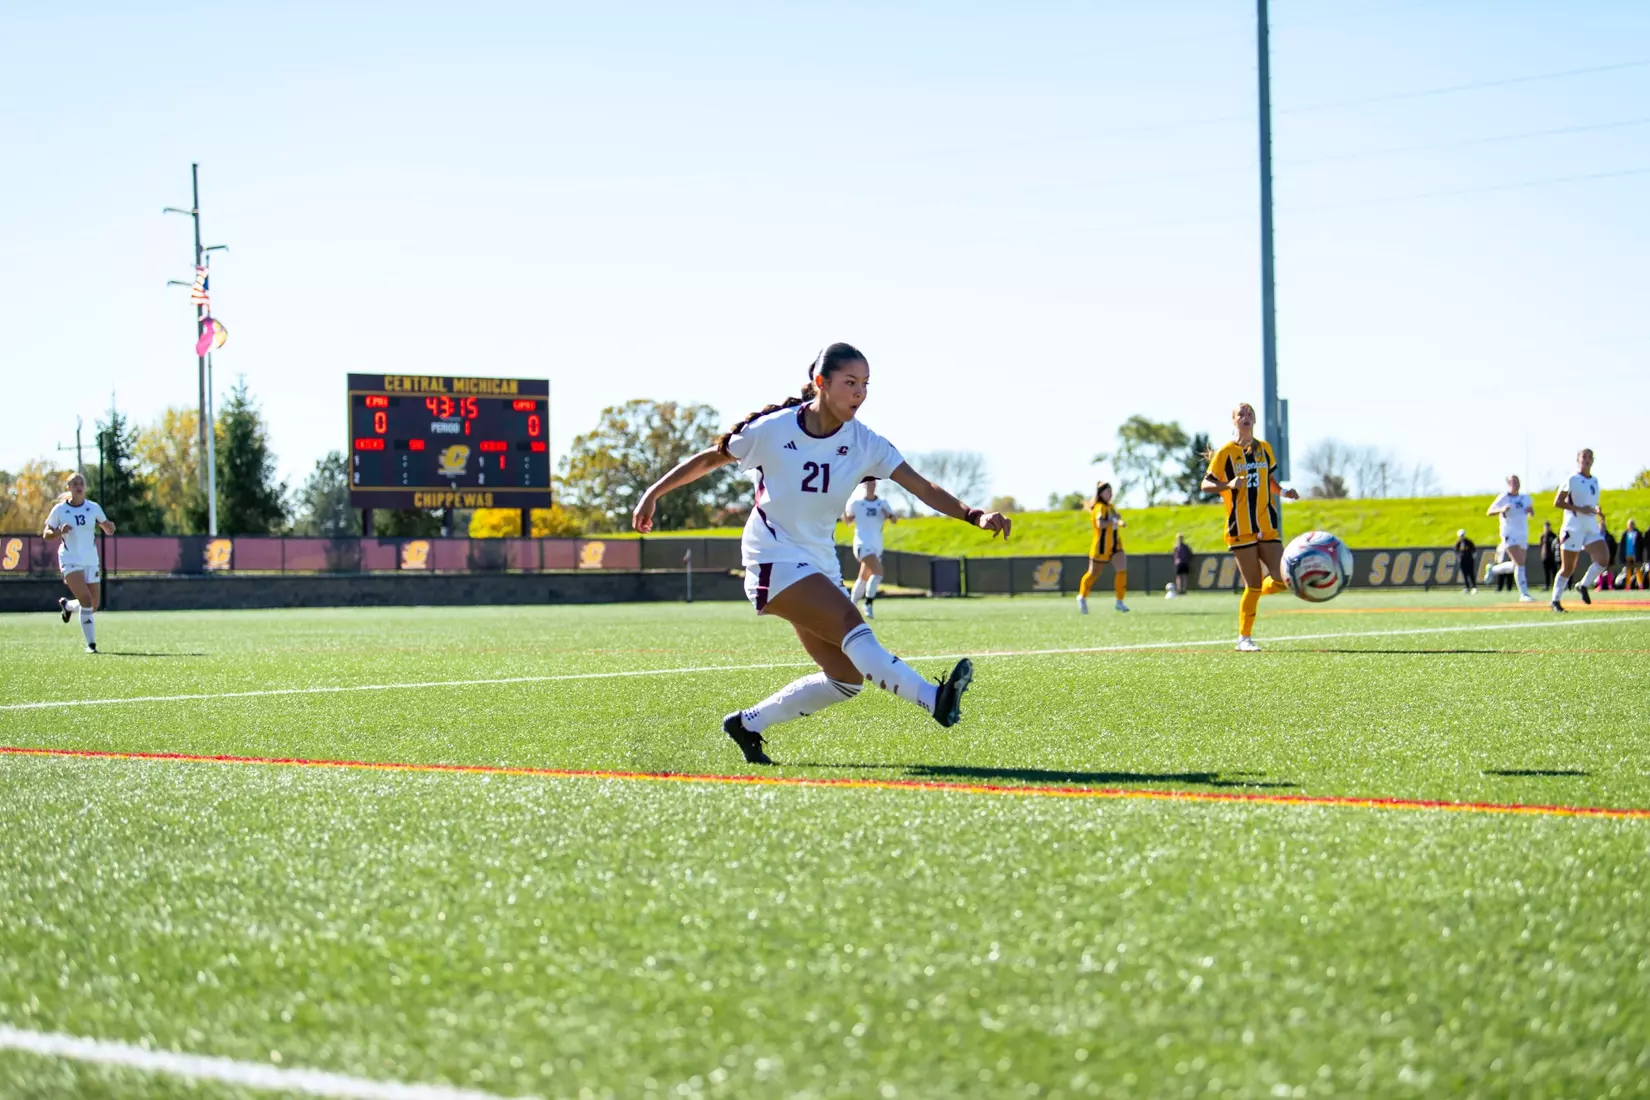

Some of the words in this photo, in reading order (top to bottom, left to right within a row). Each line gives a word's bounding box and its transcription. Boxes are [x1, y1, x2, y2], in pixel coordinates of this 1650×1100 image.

[383, 375, 447, 393] CENTRAL
[452, 378, 519, 395] MICHIGAN
[374, 411, 387, 434] 0
[430, 421, 460, 434] PERIOD
[527, 414, 540, 437] 0
[801, 461, 830, 493] 21
[1245, 472, 1260, 488] 23
[413, 491, 494, 508] CHIPPEWAS
[74, 514, 86, 526] 13
[2, 538, 24, 570] S
[1368, 550, 1498, 586] SOCC
